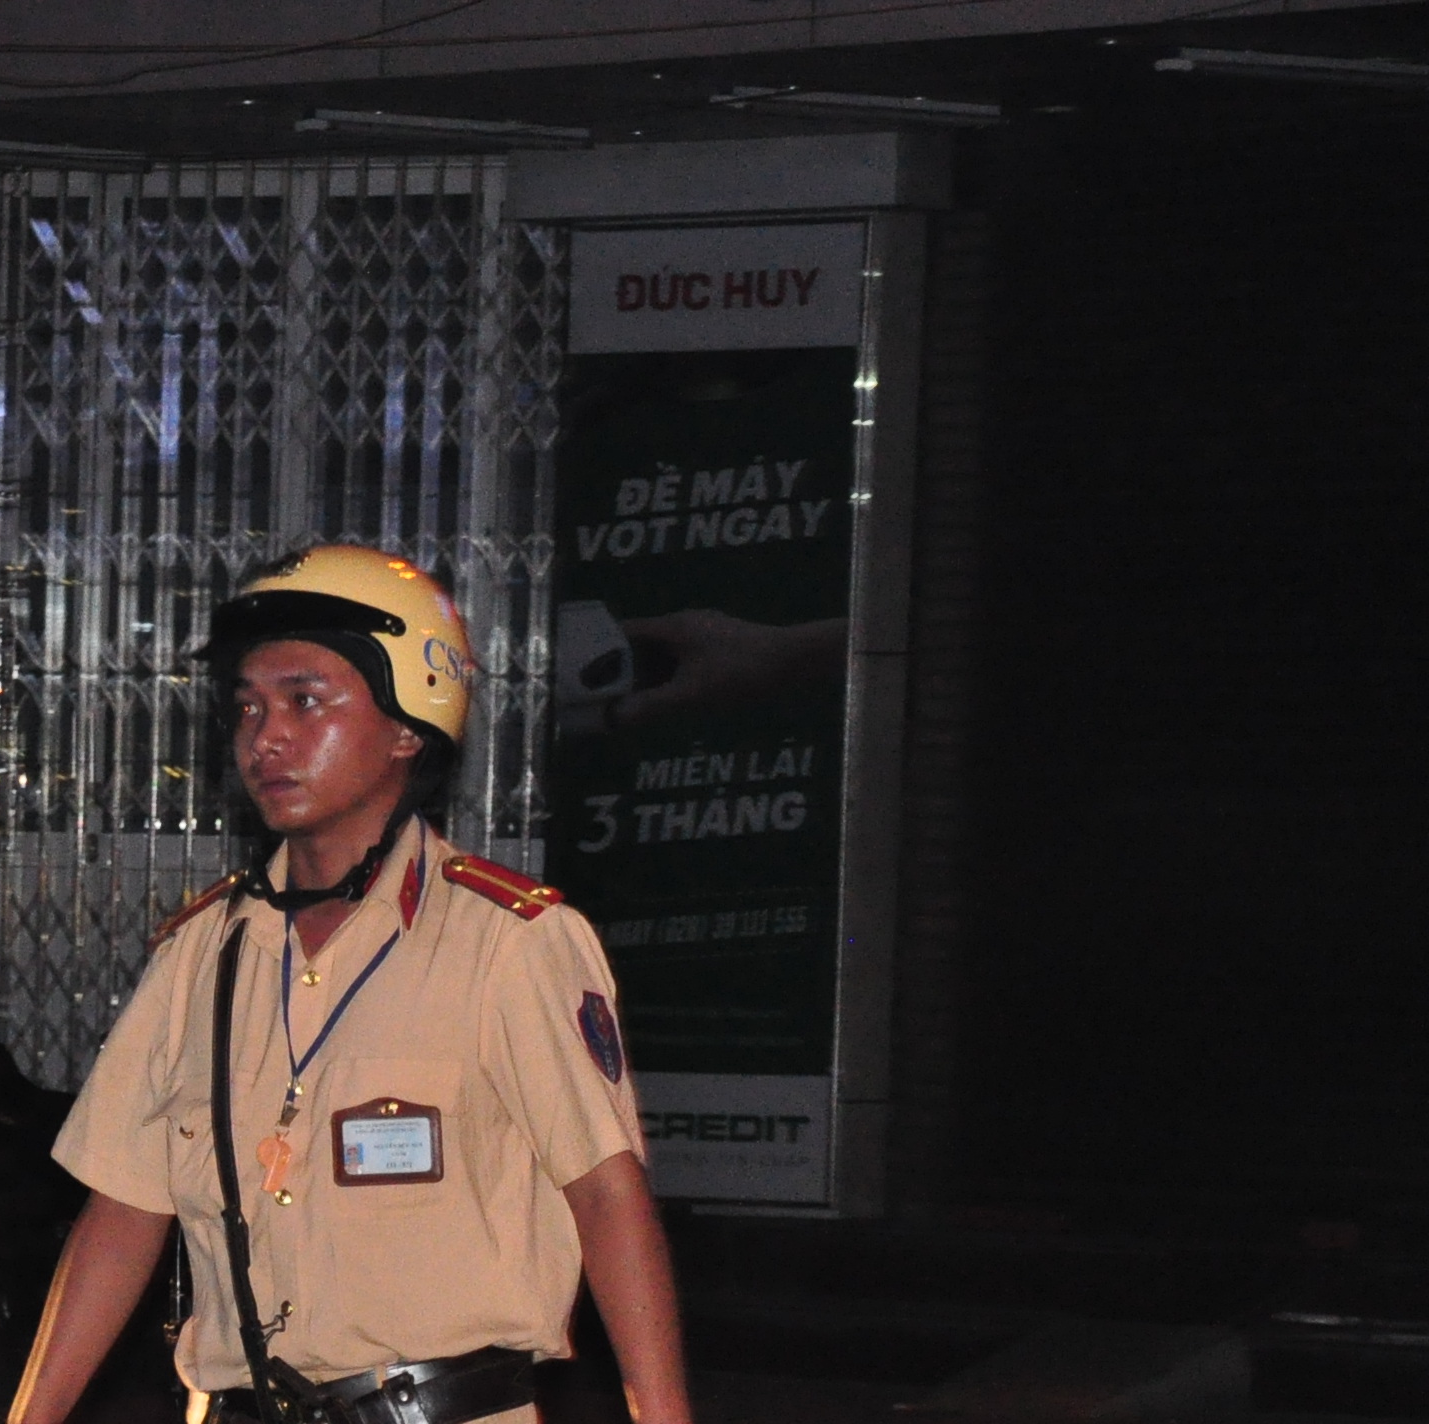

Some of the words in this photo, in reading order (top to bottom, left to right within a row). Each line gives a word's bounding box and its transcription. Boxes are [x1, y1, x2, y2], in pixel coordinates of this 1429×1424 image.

[615, 263, 712, 312] ĐỨC
[722, 266, 821, 309] HUY
[688, 455, 808, 507] MÁY
[683, 497, 832, 550] NGAY
[577, 793, 621, 853] 3
[633, 786, 808, 843] THÁNG
[639, 1111, 811, 1145] CREDIT
